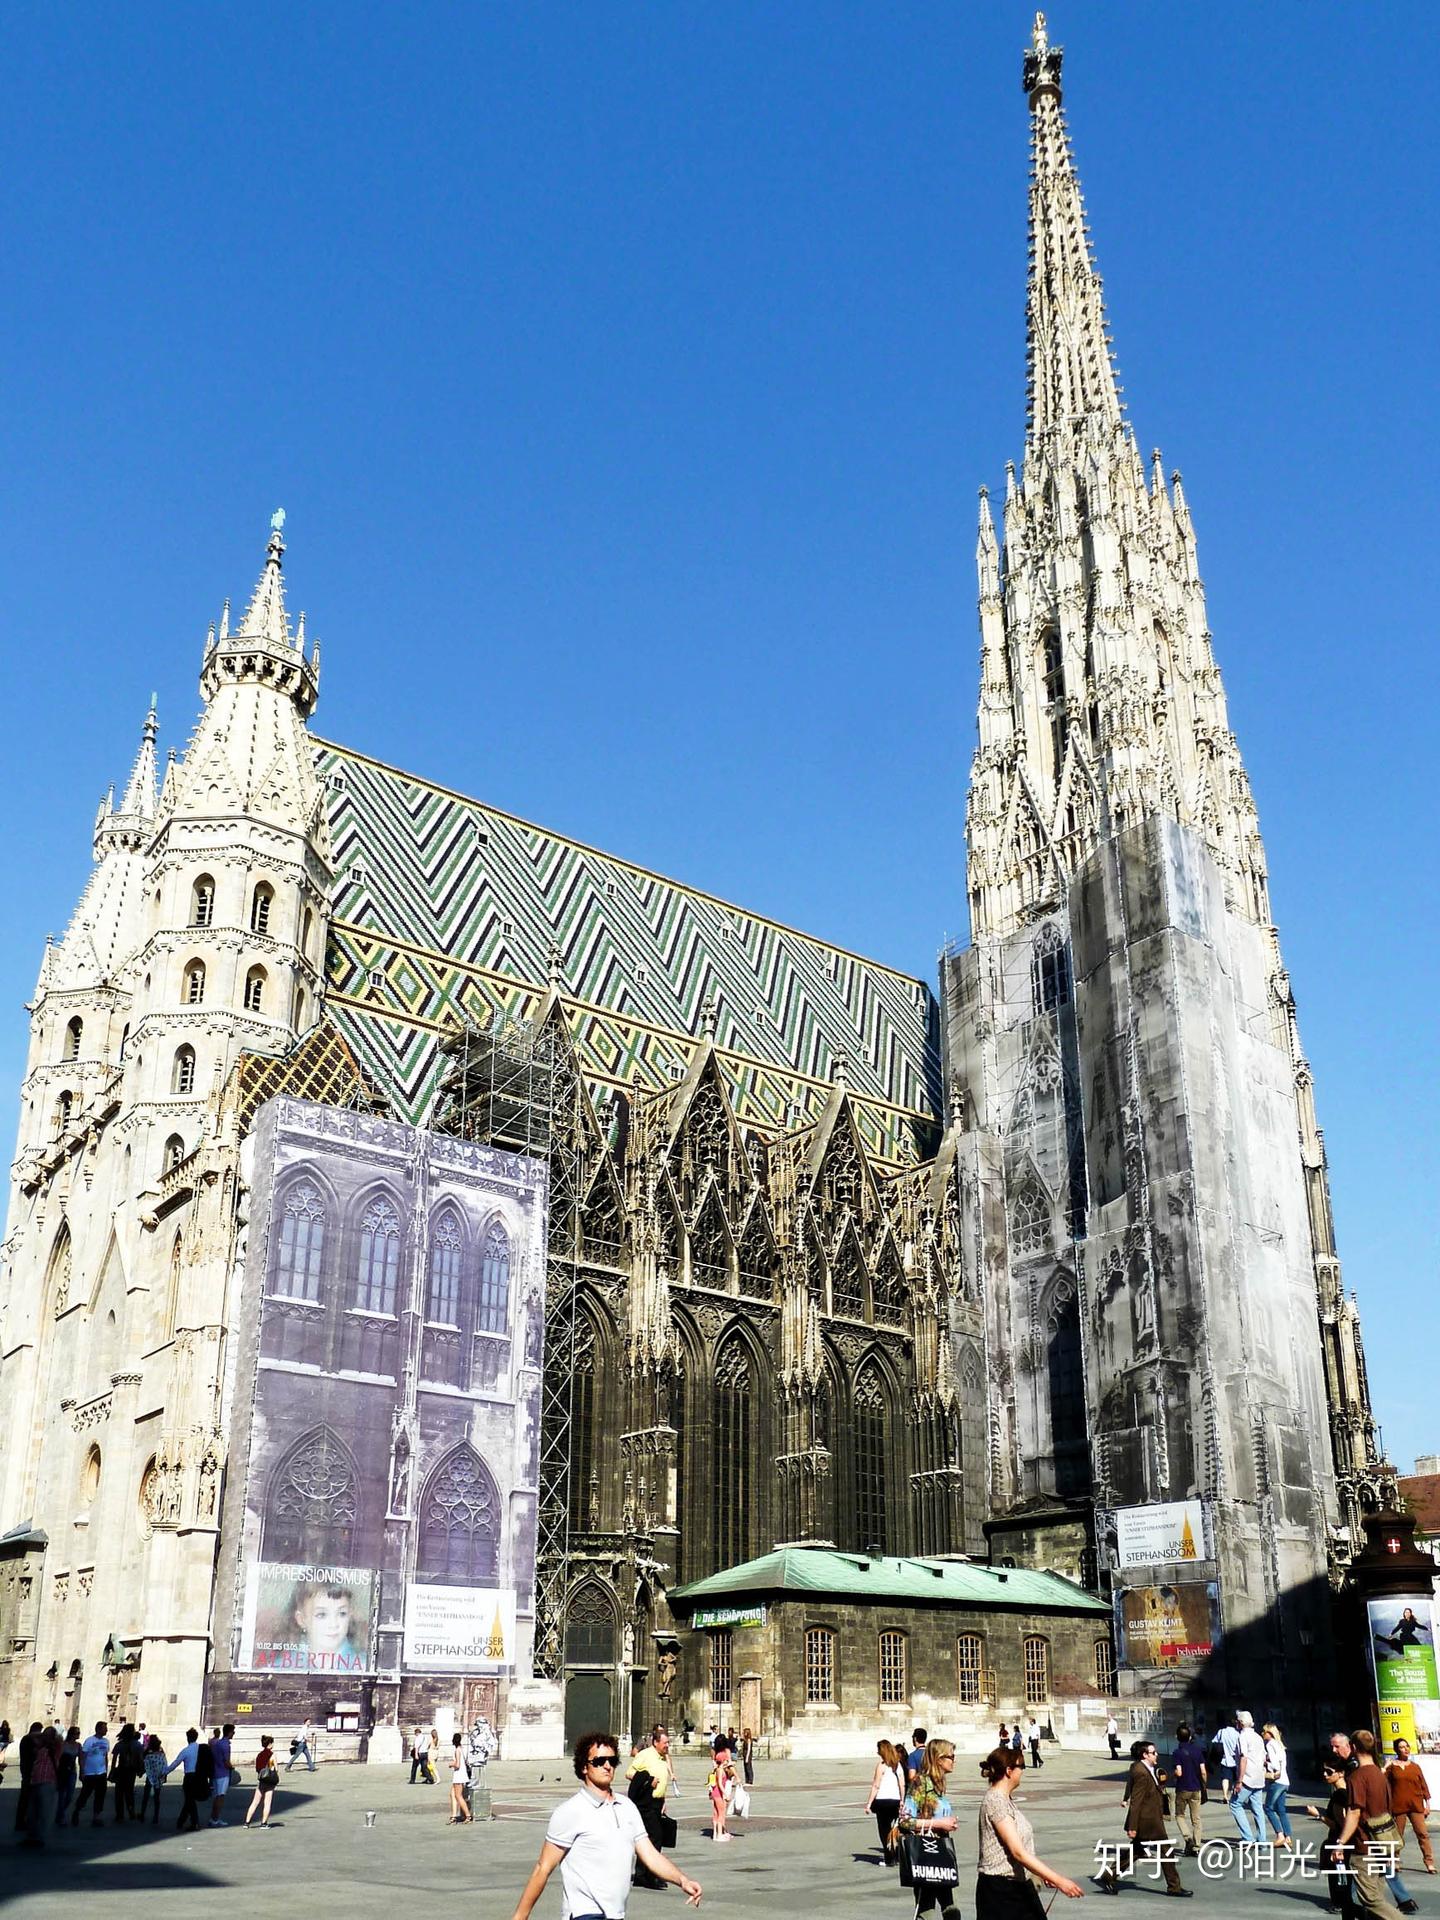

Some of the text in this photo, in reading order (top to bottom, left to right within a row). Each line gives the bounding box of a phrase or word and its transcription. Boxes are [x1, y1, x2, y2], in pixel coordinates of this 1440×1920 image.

[1169, 1539, 1194, 1549] UNSER
[1126, 1547, 1197, 1562] STEPHANSDOM
[260, 1566, 372, 1586] IMPRESSIONISMUS
[703, 1613, 715, 1623] DIE
[717, 1608, 762, 1623] SCHÖPFUNG
[1128, 1618, 1183, 1629] GUSTAV KLIMT
[473, 1636, 504, 1646] UNSER
[414, 1643, 505, 1657] STEPHANSDOM
[1176, 1645, 1212, 1657] belvedere
[255, 1651, 363, 1670] ALBERTINA
[1389, 1669, 1426, 1677] The Sound
[1396, 1676, 1427, 1684] of Music
[911, 1864, 958, 1881] HUMANIC
